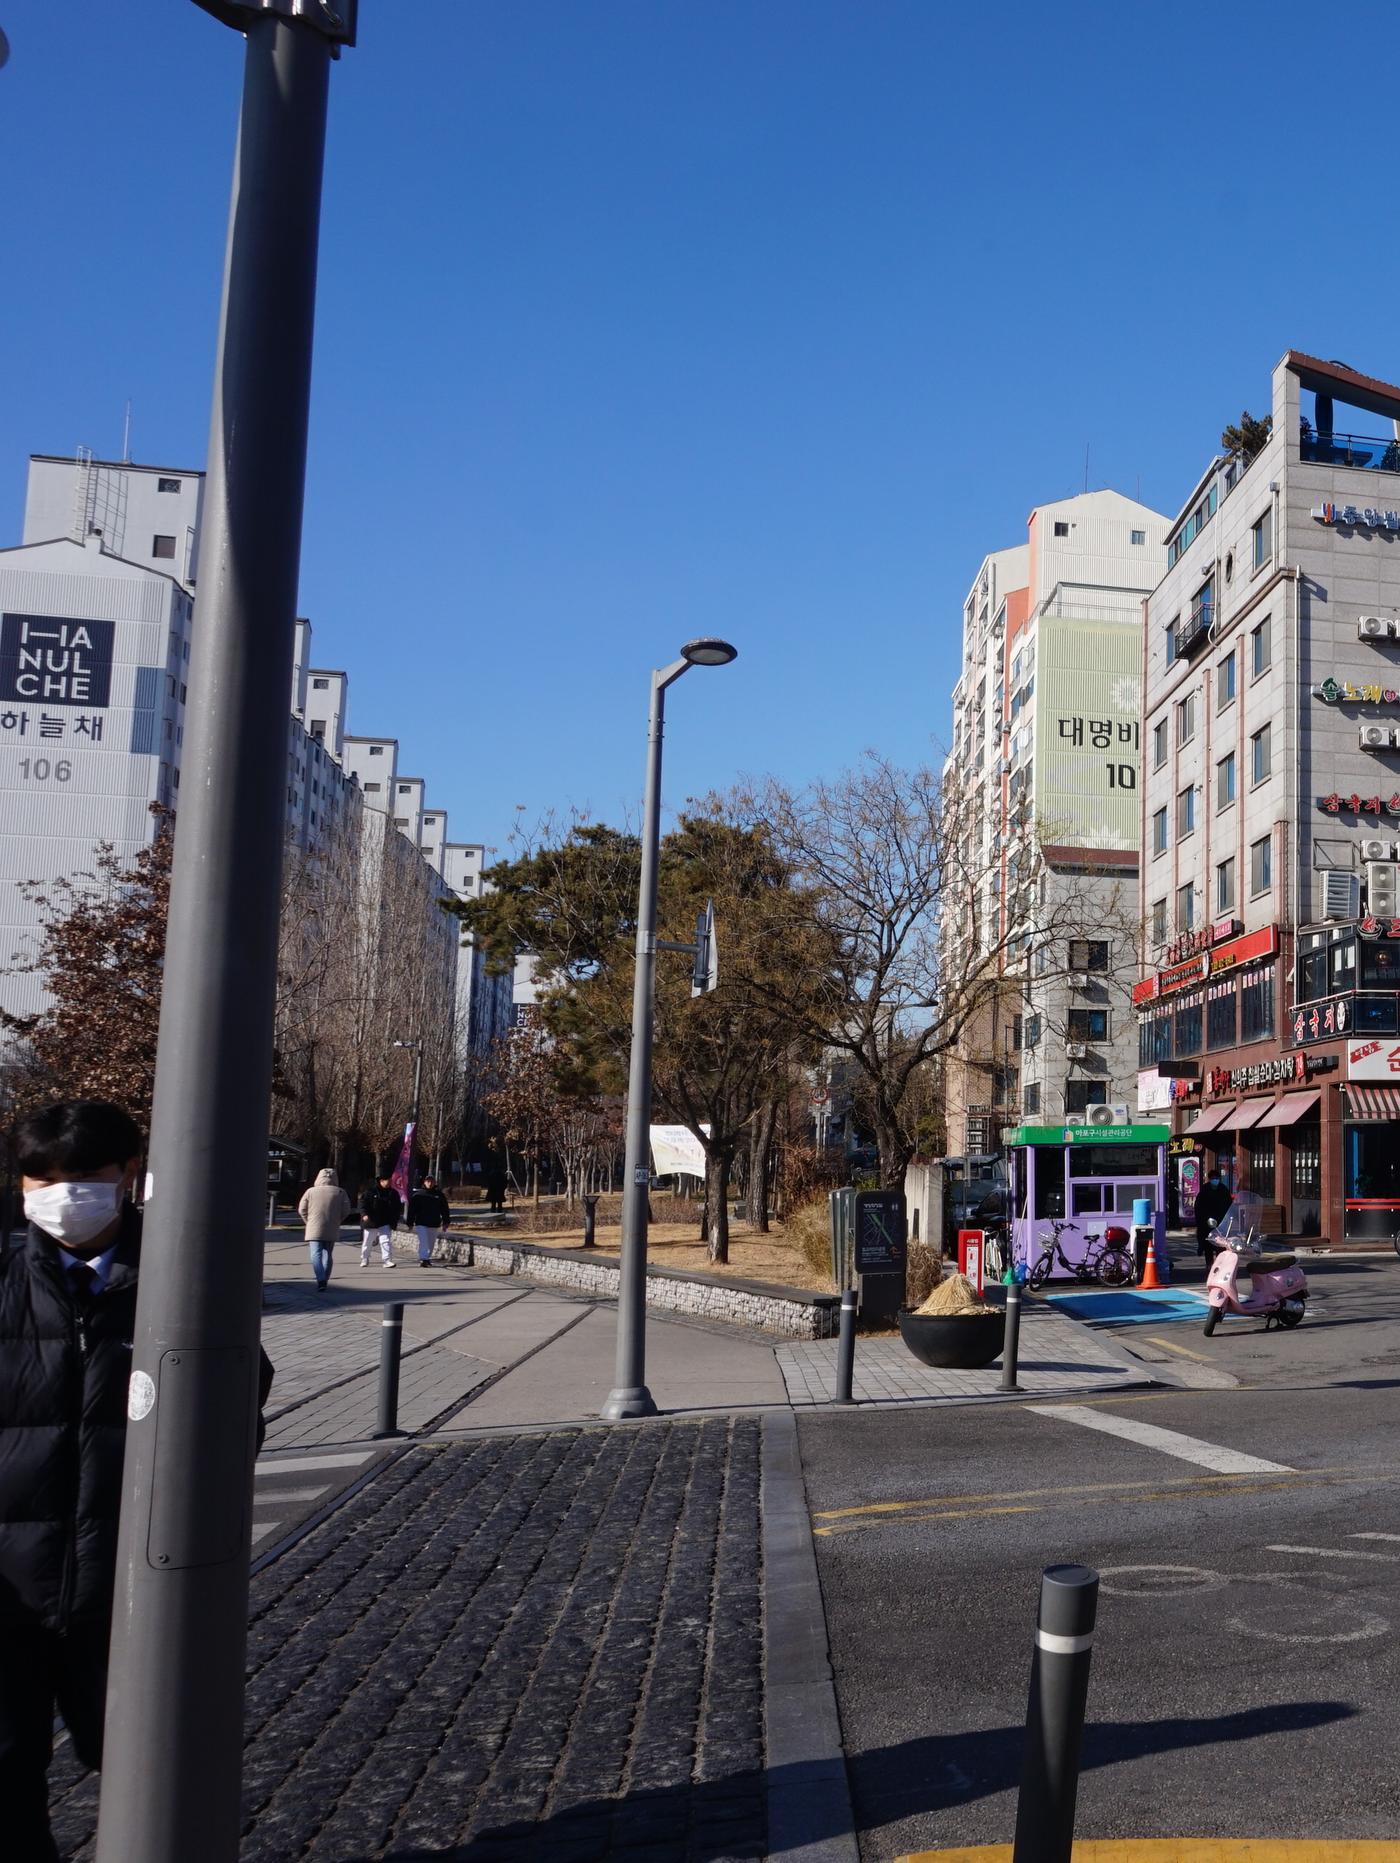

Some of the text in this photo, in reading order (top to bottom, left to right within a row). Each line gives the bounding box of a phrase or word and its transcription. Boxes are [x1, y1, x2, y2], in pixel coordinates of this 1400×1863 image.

[19, 648, 91, 674] NUL
[16, 674, 91, 700] CHE
[0, 711, 103, 741] 하늘채
[1058, 717, 1139, 750] 대명비
[18, 758, 72, 782] 106
[1106, 763, 1140, 789] 10
[1322, 793, 1381, 815] 삼국지
